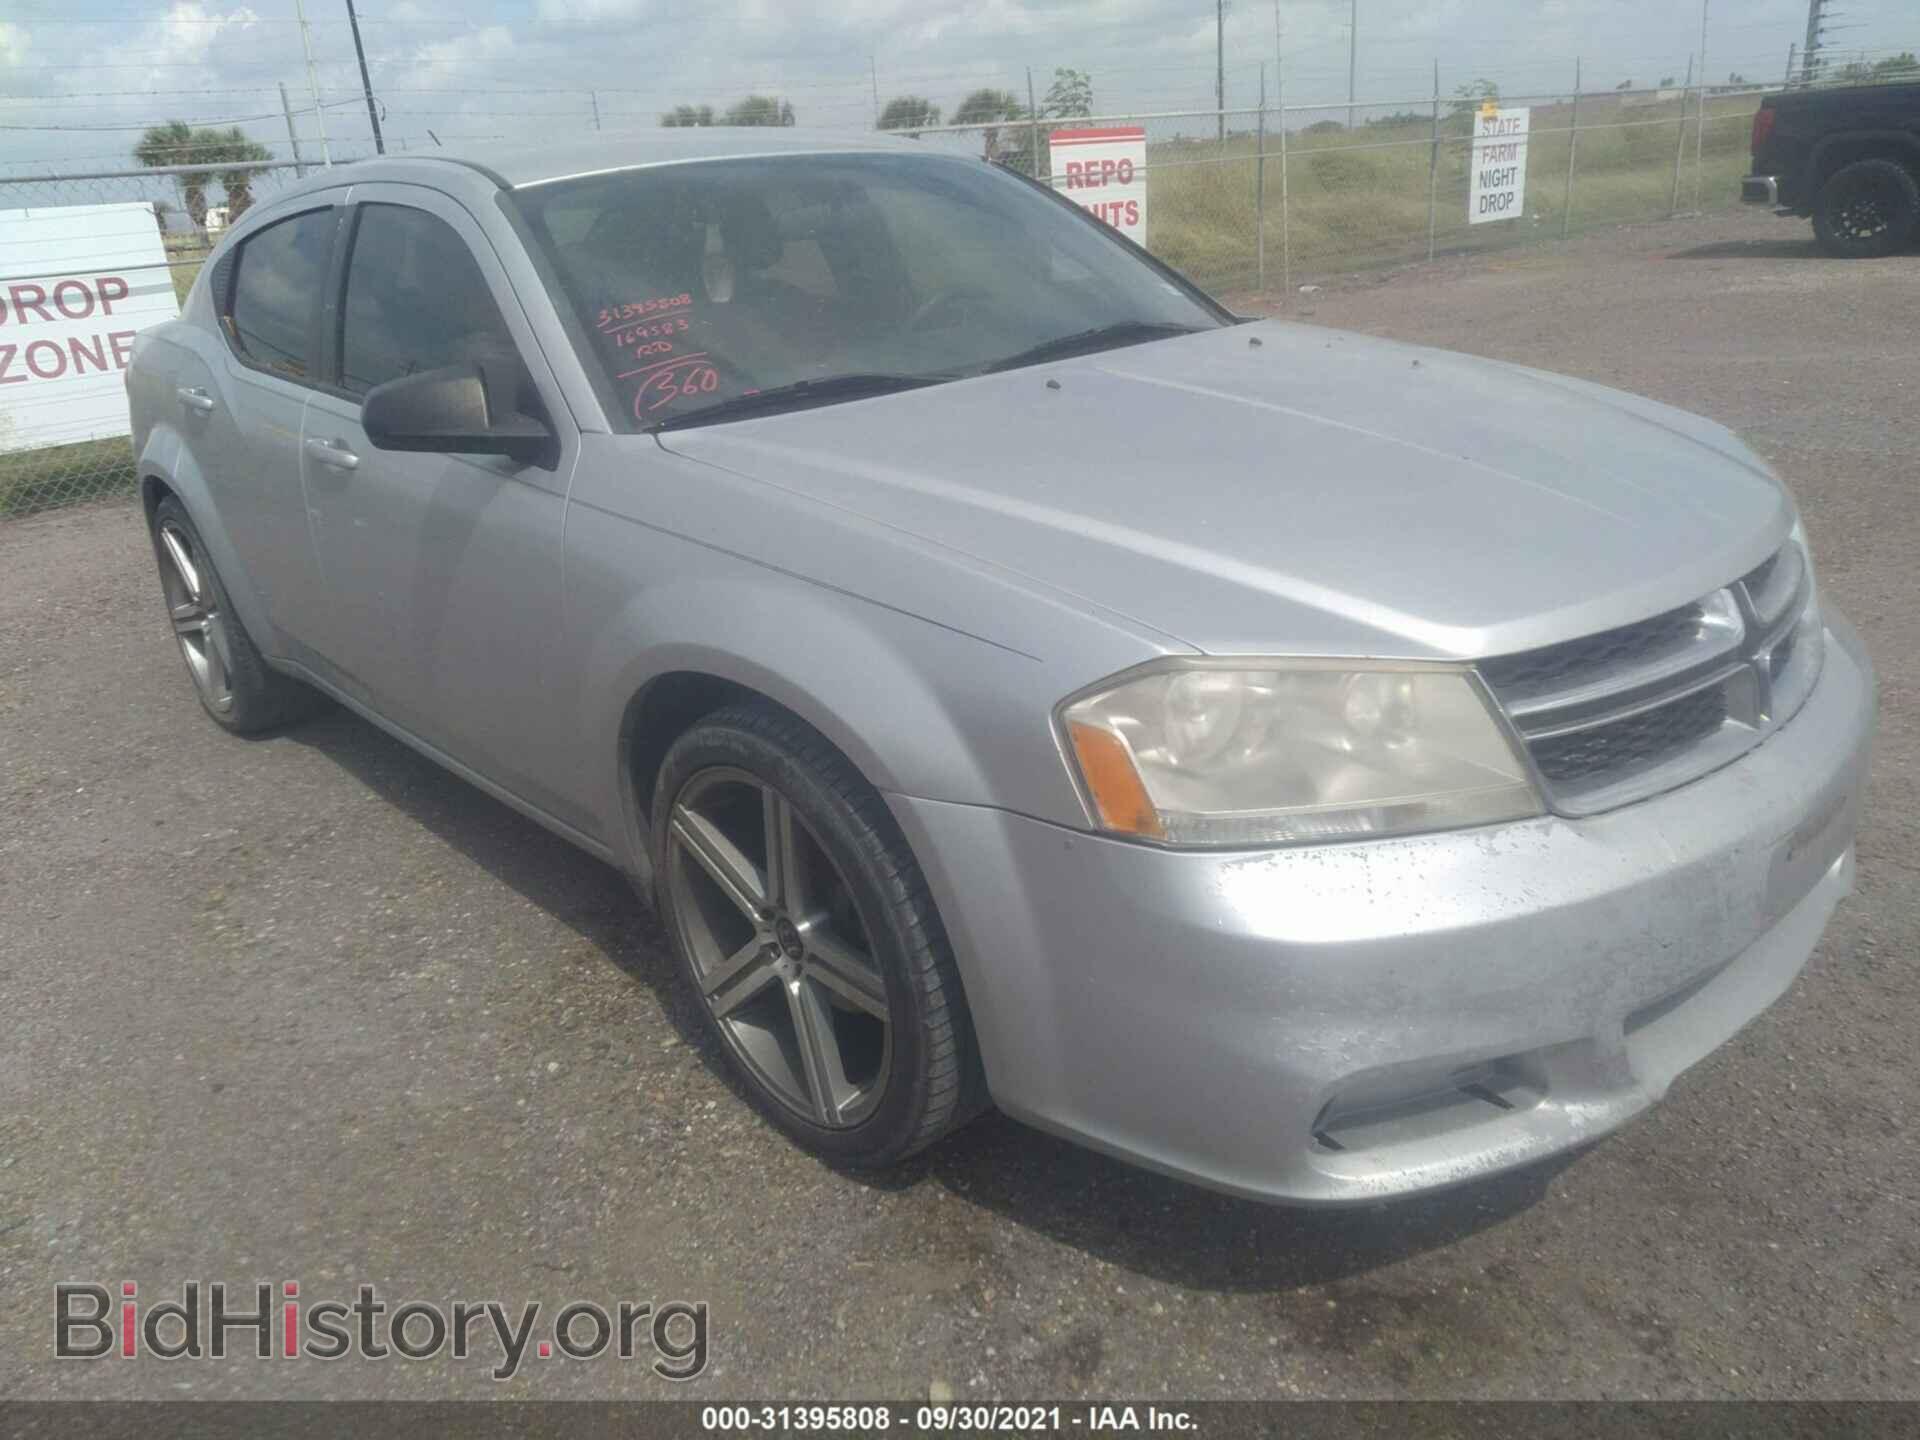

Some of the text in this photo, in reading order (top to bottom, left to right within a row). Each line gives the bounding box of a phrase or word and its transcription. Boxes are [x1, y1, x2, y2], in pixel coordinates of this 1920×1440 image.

[1482, 143, 1519, 164] FARM
[1066, 158, 1135, 189] REPO
[1479, 167, 1517, 189] NIGHT
[1479, 192, 1514, 214] DROP
[0, 277, 129, 328] ROP
